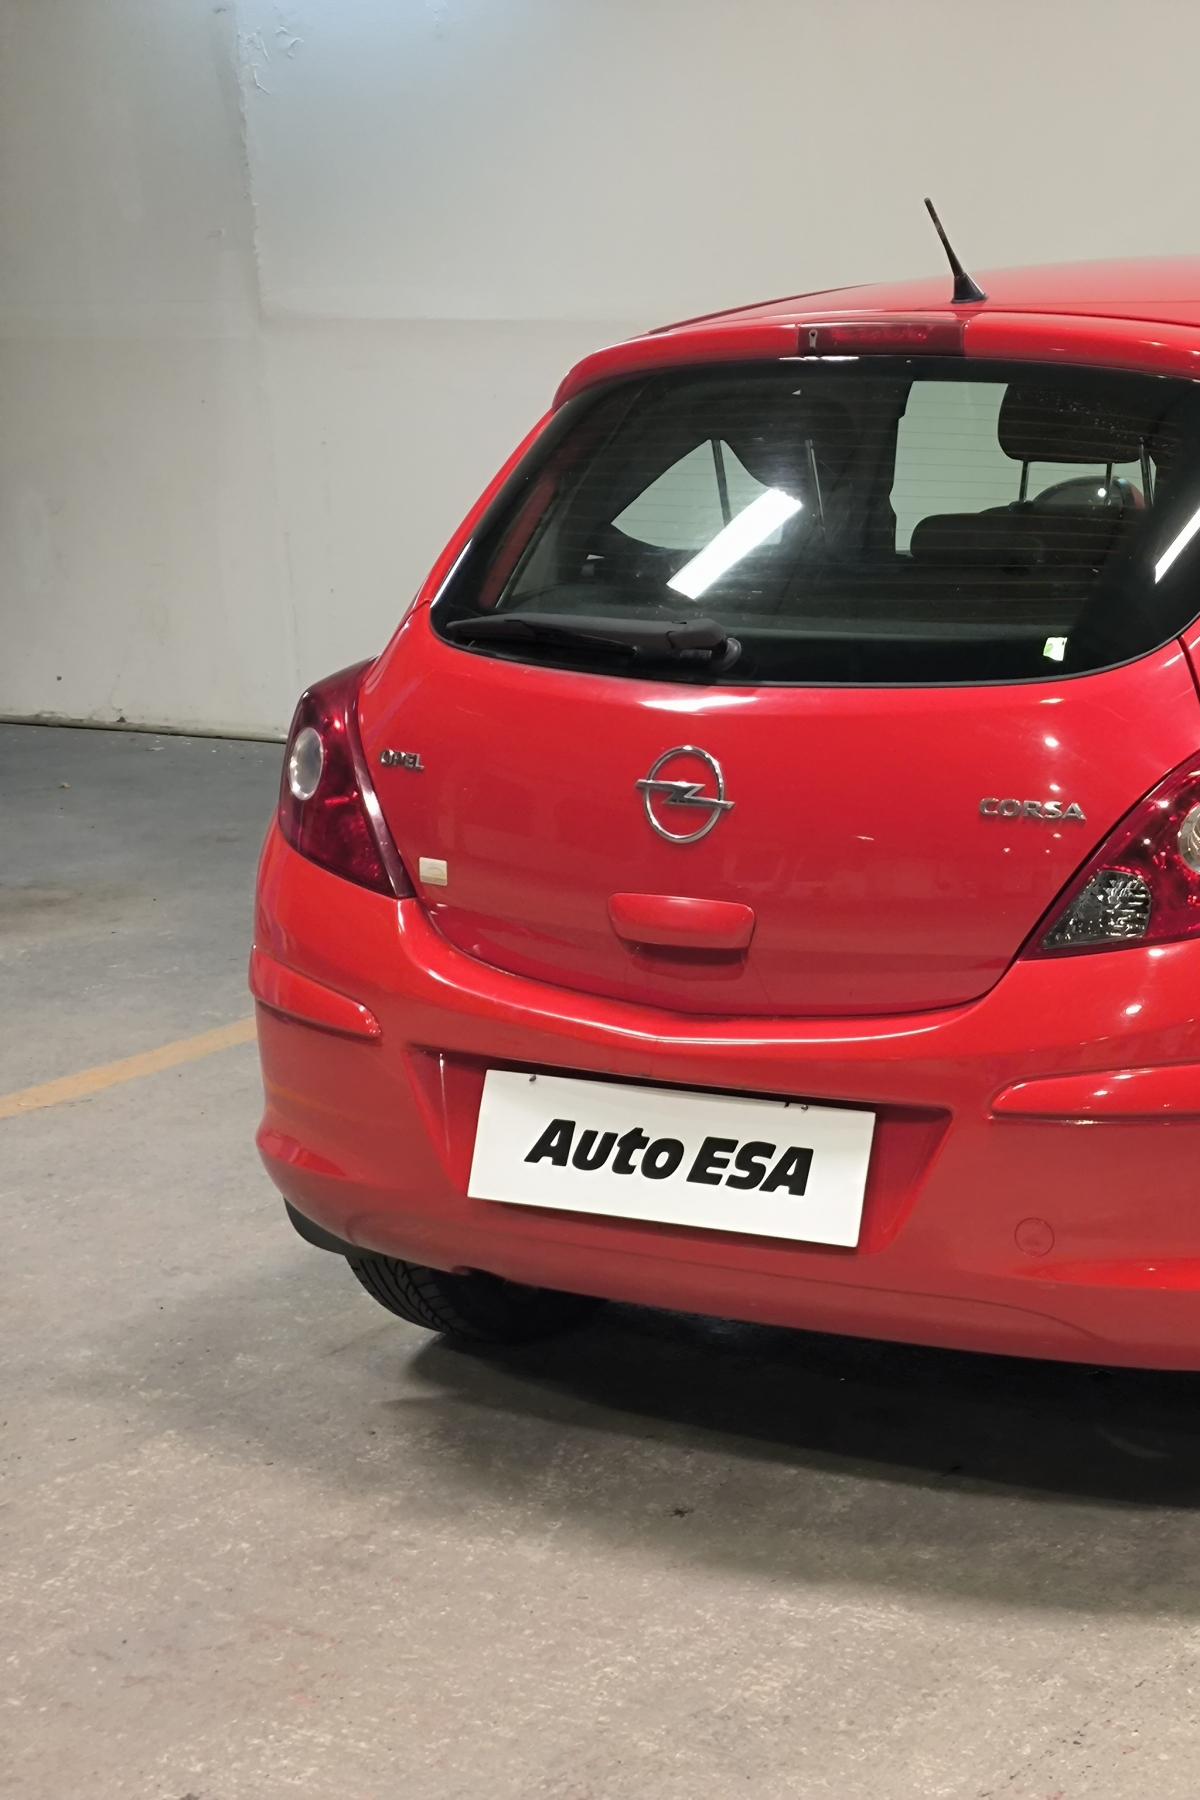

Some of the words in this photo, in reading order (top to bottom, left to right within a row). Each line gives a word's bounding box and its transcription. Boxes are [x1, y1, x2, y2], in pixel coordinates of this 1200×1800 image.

[381, 750, 425, 770] OPEL
[980, 798, 1087, 821] CORSA
[524, 1118, 685, 1180] Auto
[686, 1136, 814, 1197] ESA
